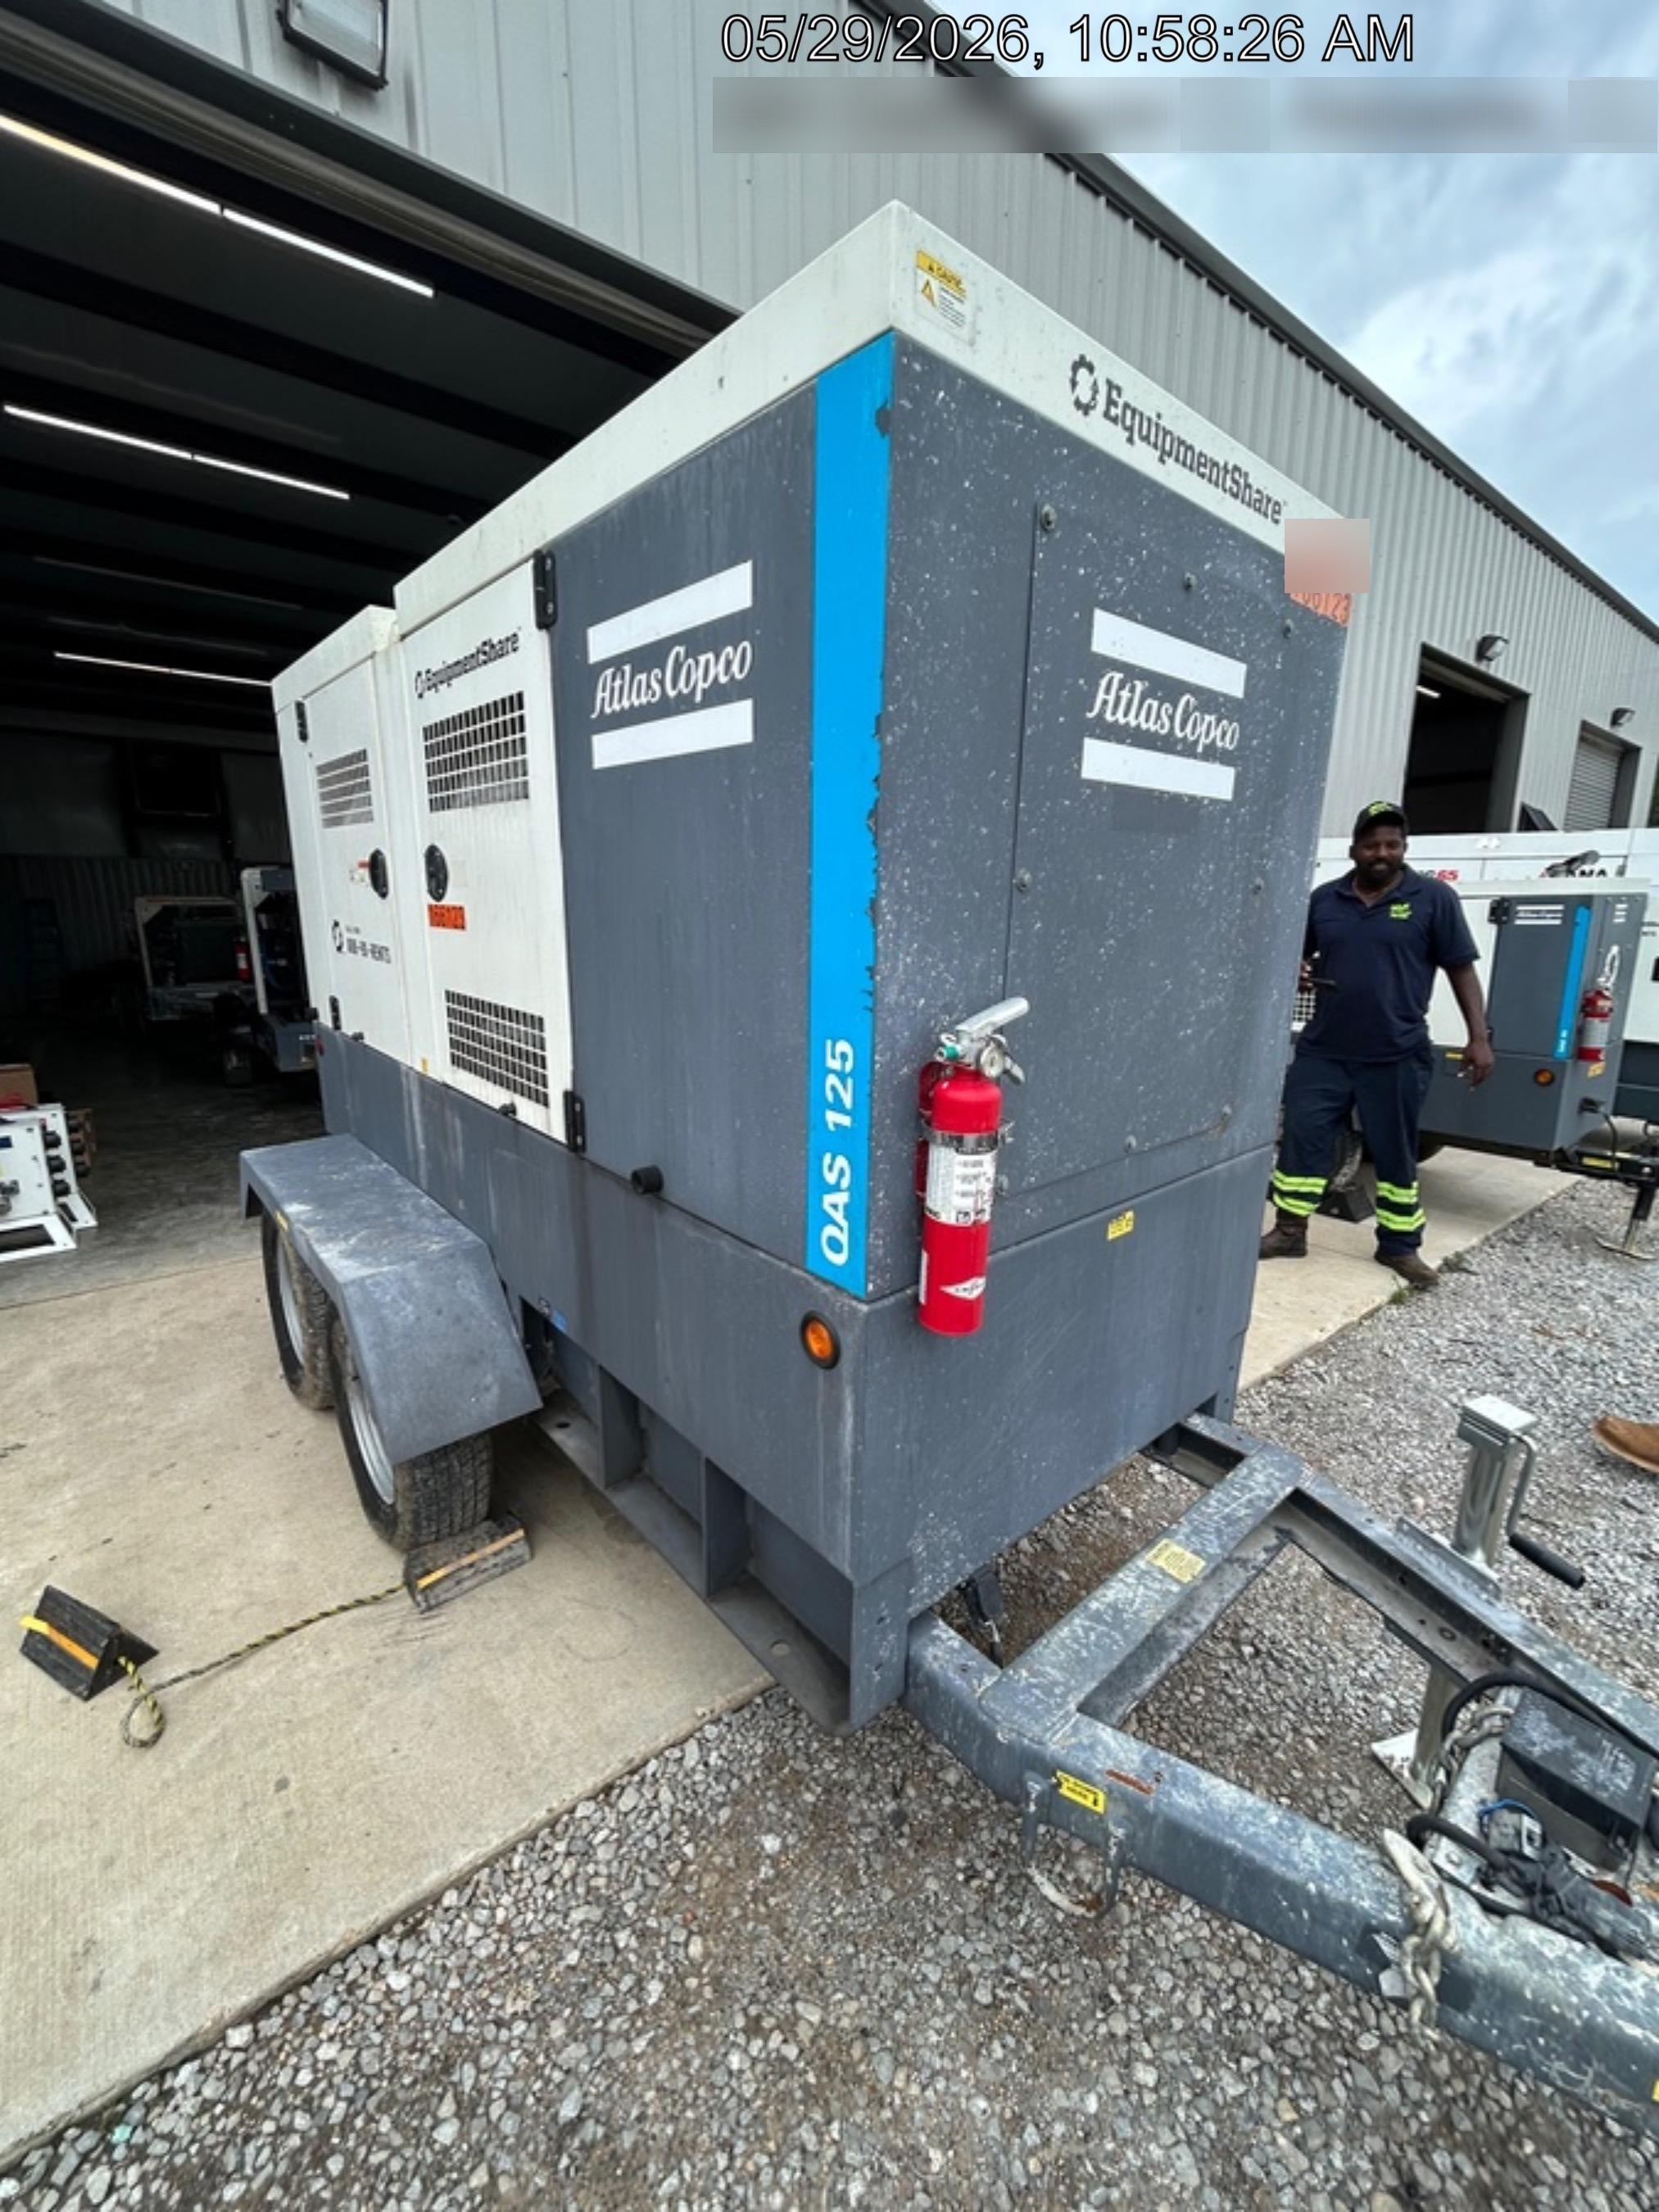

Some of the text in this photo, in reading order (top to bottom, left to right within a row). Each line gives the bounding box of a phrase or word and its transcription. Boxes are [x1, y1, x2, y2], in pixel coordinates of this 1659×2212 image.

[1102, 377, 1283, 525] EquipmentShare
[591, 640, 753, 719] Atlas Copco
[1086, 670, 1240, 753] Atlas Copco
[825, 1037, 854, 1132] 125
